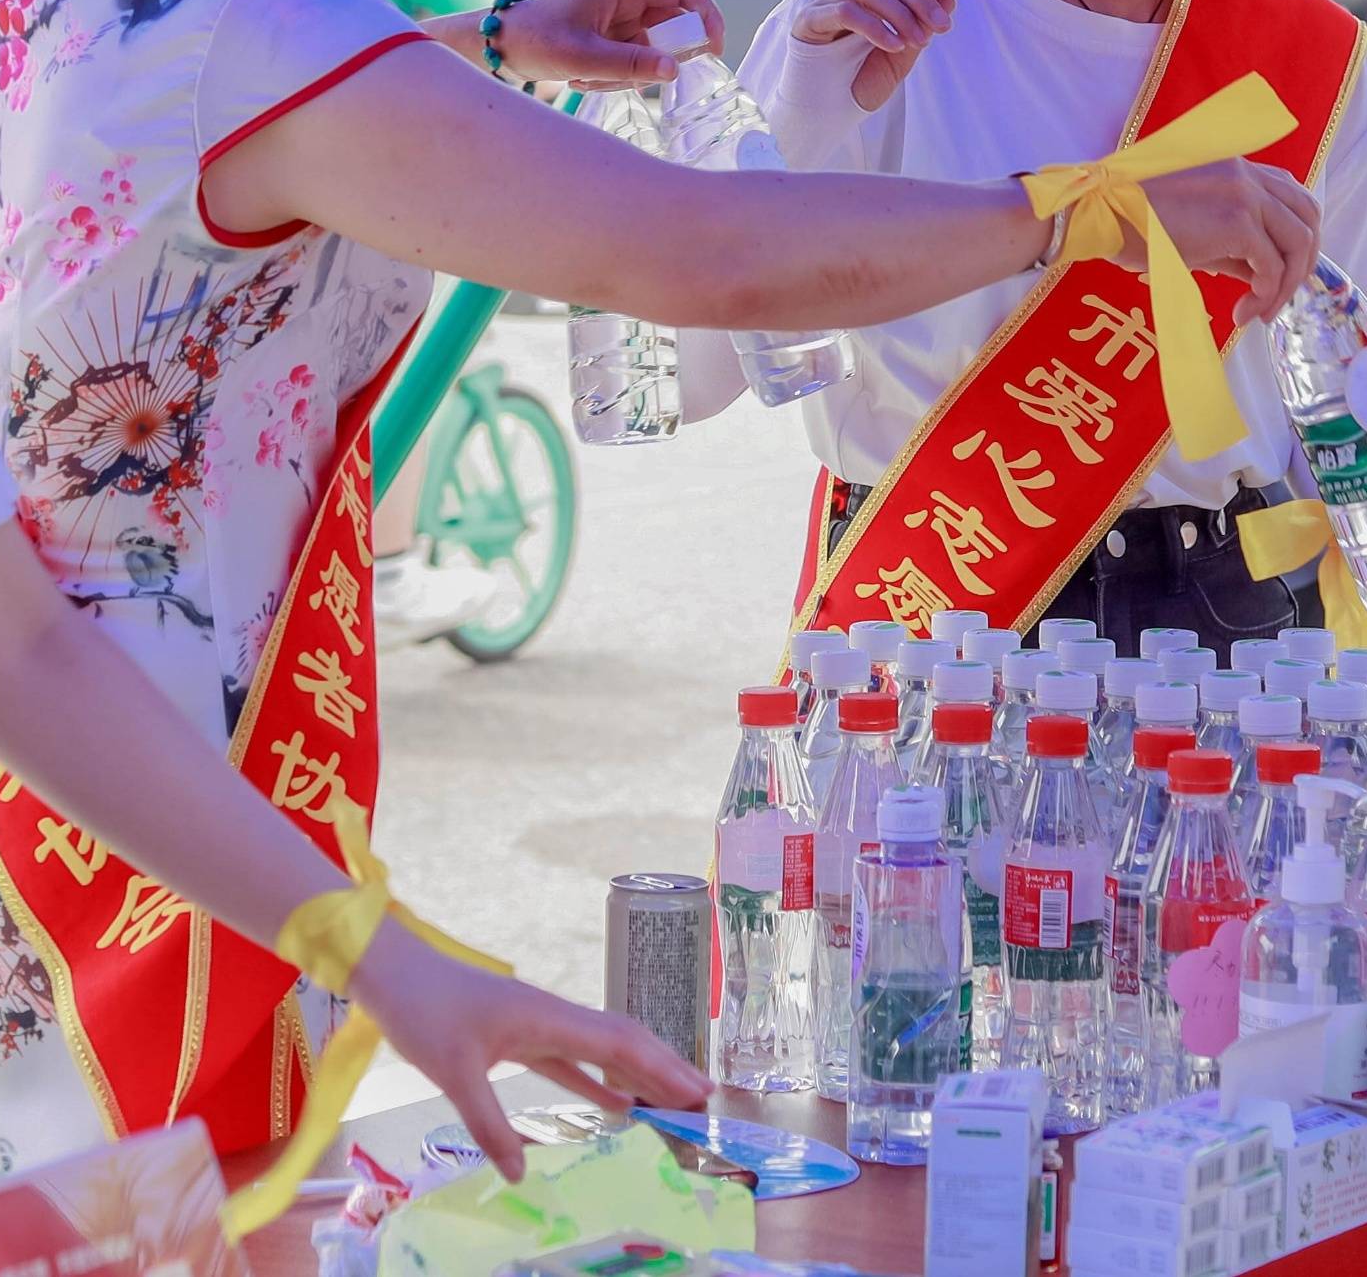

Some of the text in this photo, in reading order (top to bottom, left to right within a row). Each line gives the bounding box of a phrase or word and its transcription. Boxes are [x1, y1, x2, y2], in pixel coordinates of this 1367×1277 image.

[270, 443, 374, 824] 志愿者协
[827, 273, 1214, 640] 市爱心志愿
